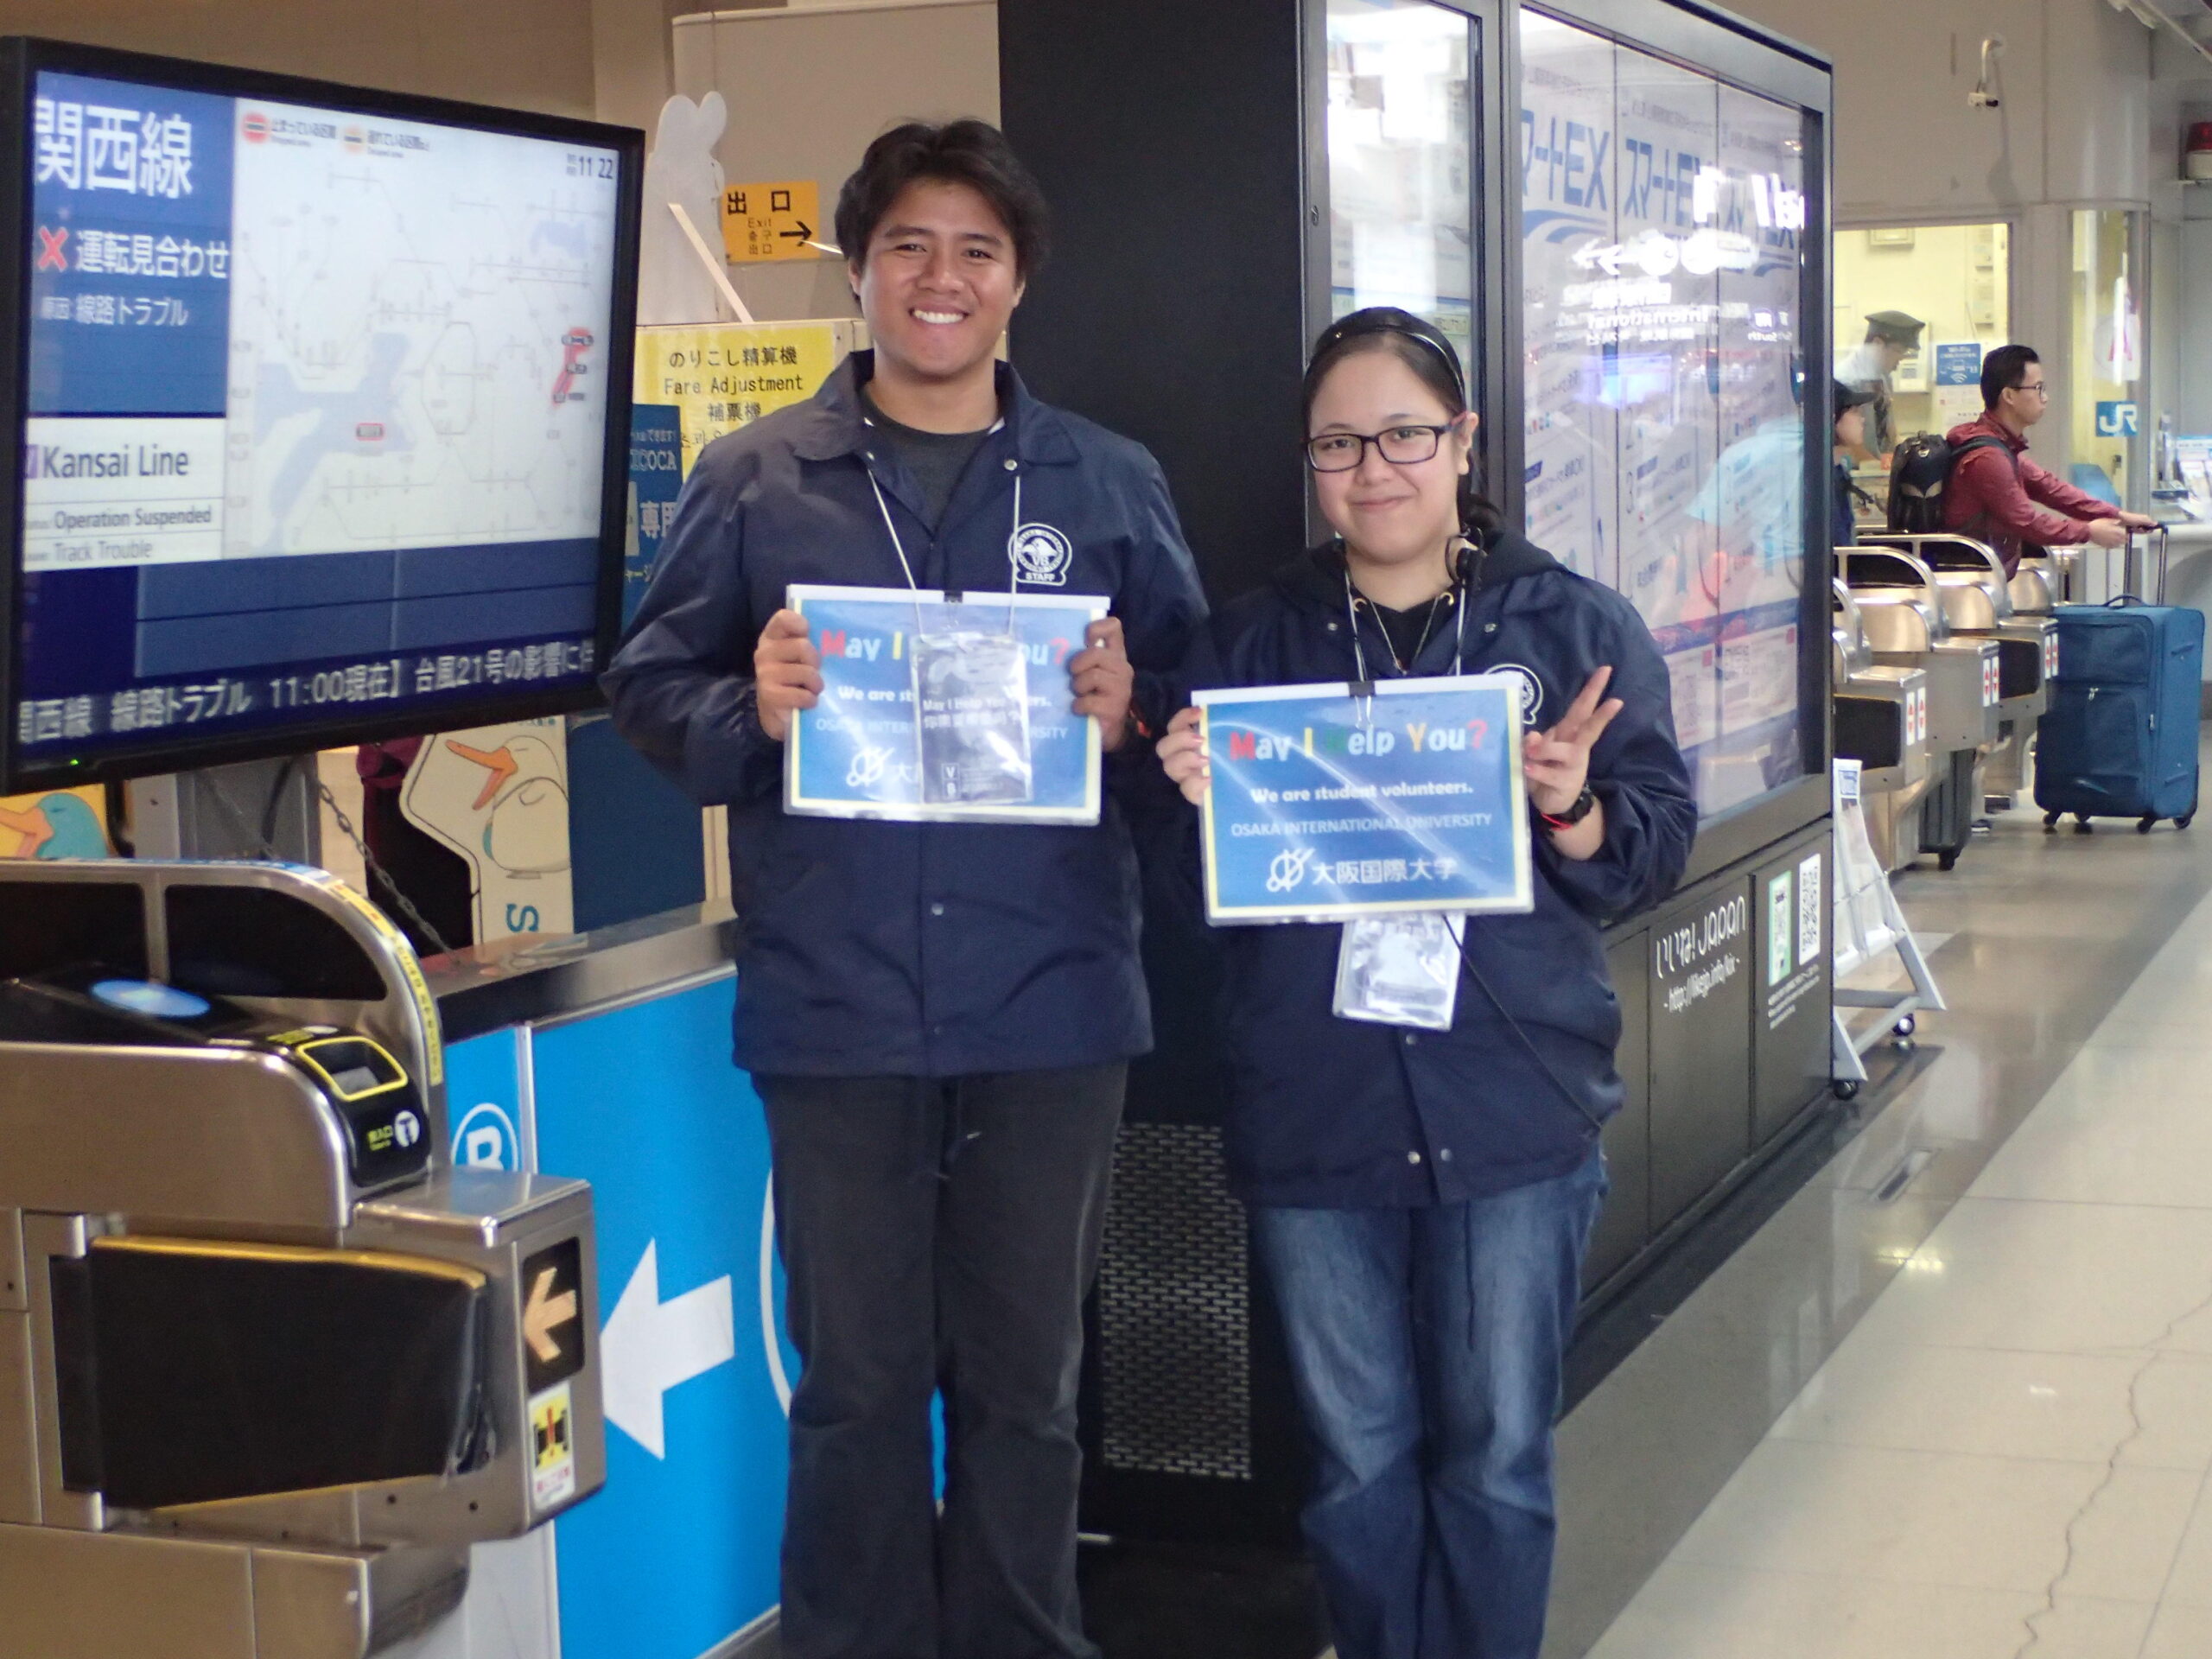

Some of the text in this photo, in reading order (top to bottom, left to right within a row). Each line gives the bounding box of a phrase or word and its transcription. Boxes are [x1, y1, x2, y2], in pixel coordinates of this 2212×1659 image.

[35, 98, 194, 200] 関西線
[1624, 138, 1700, 227] スマートE
[728, 190, 791, 215] 出口
[747, 217, 772, 229] Exit
[75, 230, 231, 278] 運転見合わせ
[75, 293, 188, 327] 線路トラブル
[669, 346, 798, 368] のりこし精算機
[664, 374, 803, 395] Fare Adjustment
[2100, 404, 2138, 433] JR
[43, 443, 188, 479] Kansai Line
[54, 511, 130, 533] Operation
[135, 505, 212, 530] Suspended
[54, 542, 92, 562] Track
[98, 539, 153, 559] Trouble
[1026, 571, 1055, 582] STAFF
[821, 630, 881, 662] May
[892, 631, 903, 660] I
[111, 677, 253, 733] 線路トラブル
[837, 684, 864, 701] We
[868, 689, 896, 702] are
[1230, 719, 1489, 761] May I Help You?
[1251, 782, 1474, 803] We are student volunteers.
[1231, 813, 1492, 836] OSAKA INTERNATIONAL UNIVERSITY
[1312, 857, 1459, 886] 大阪国際大学
